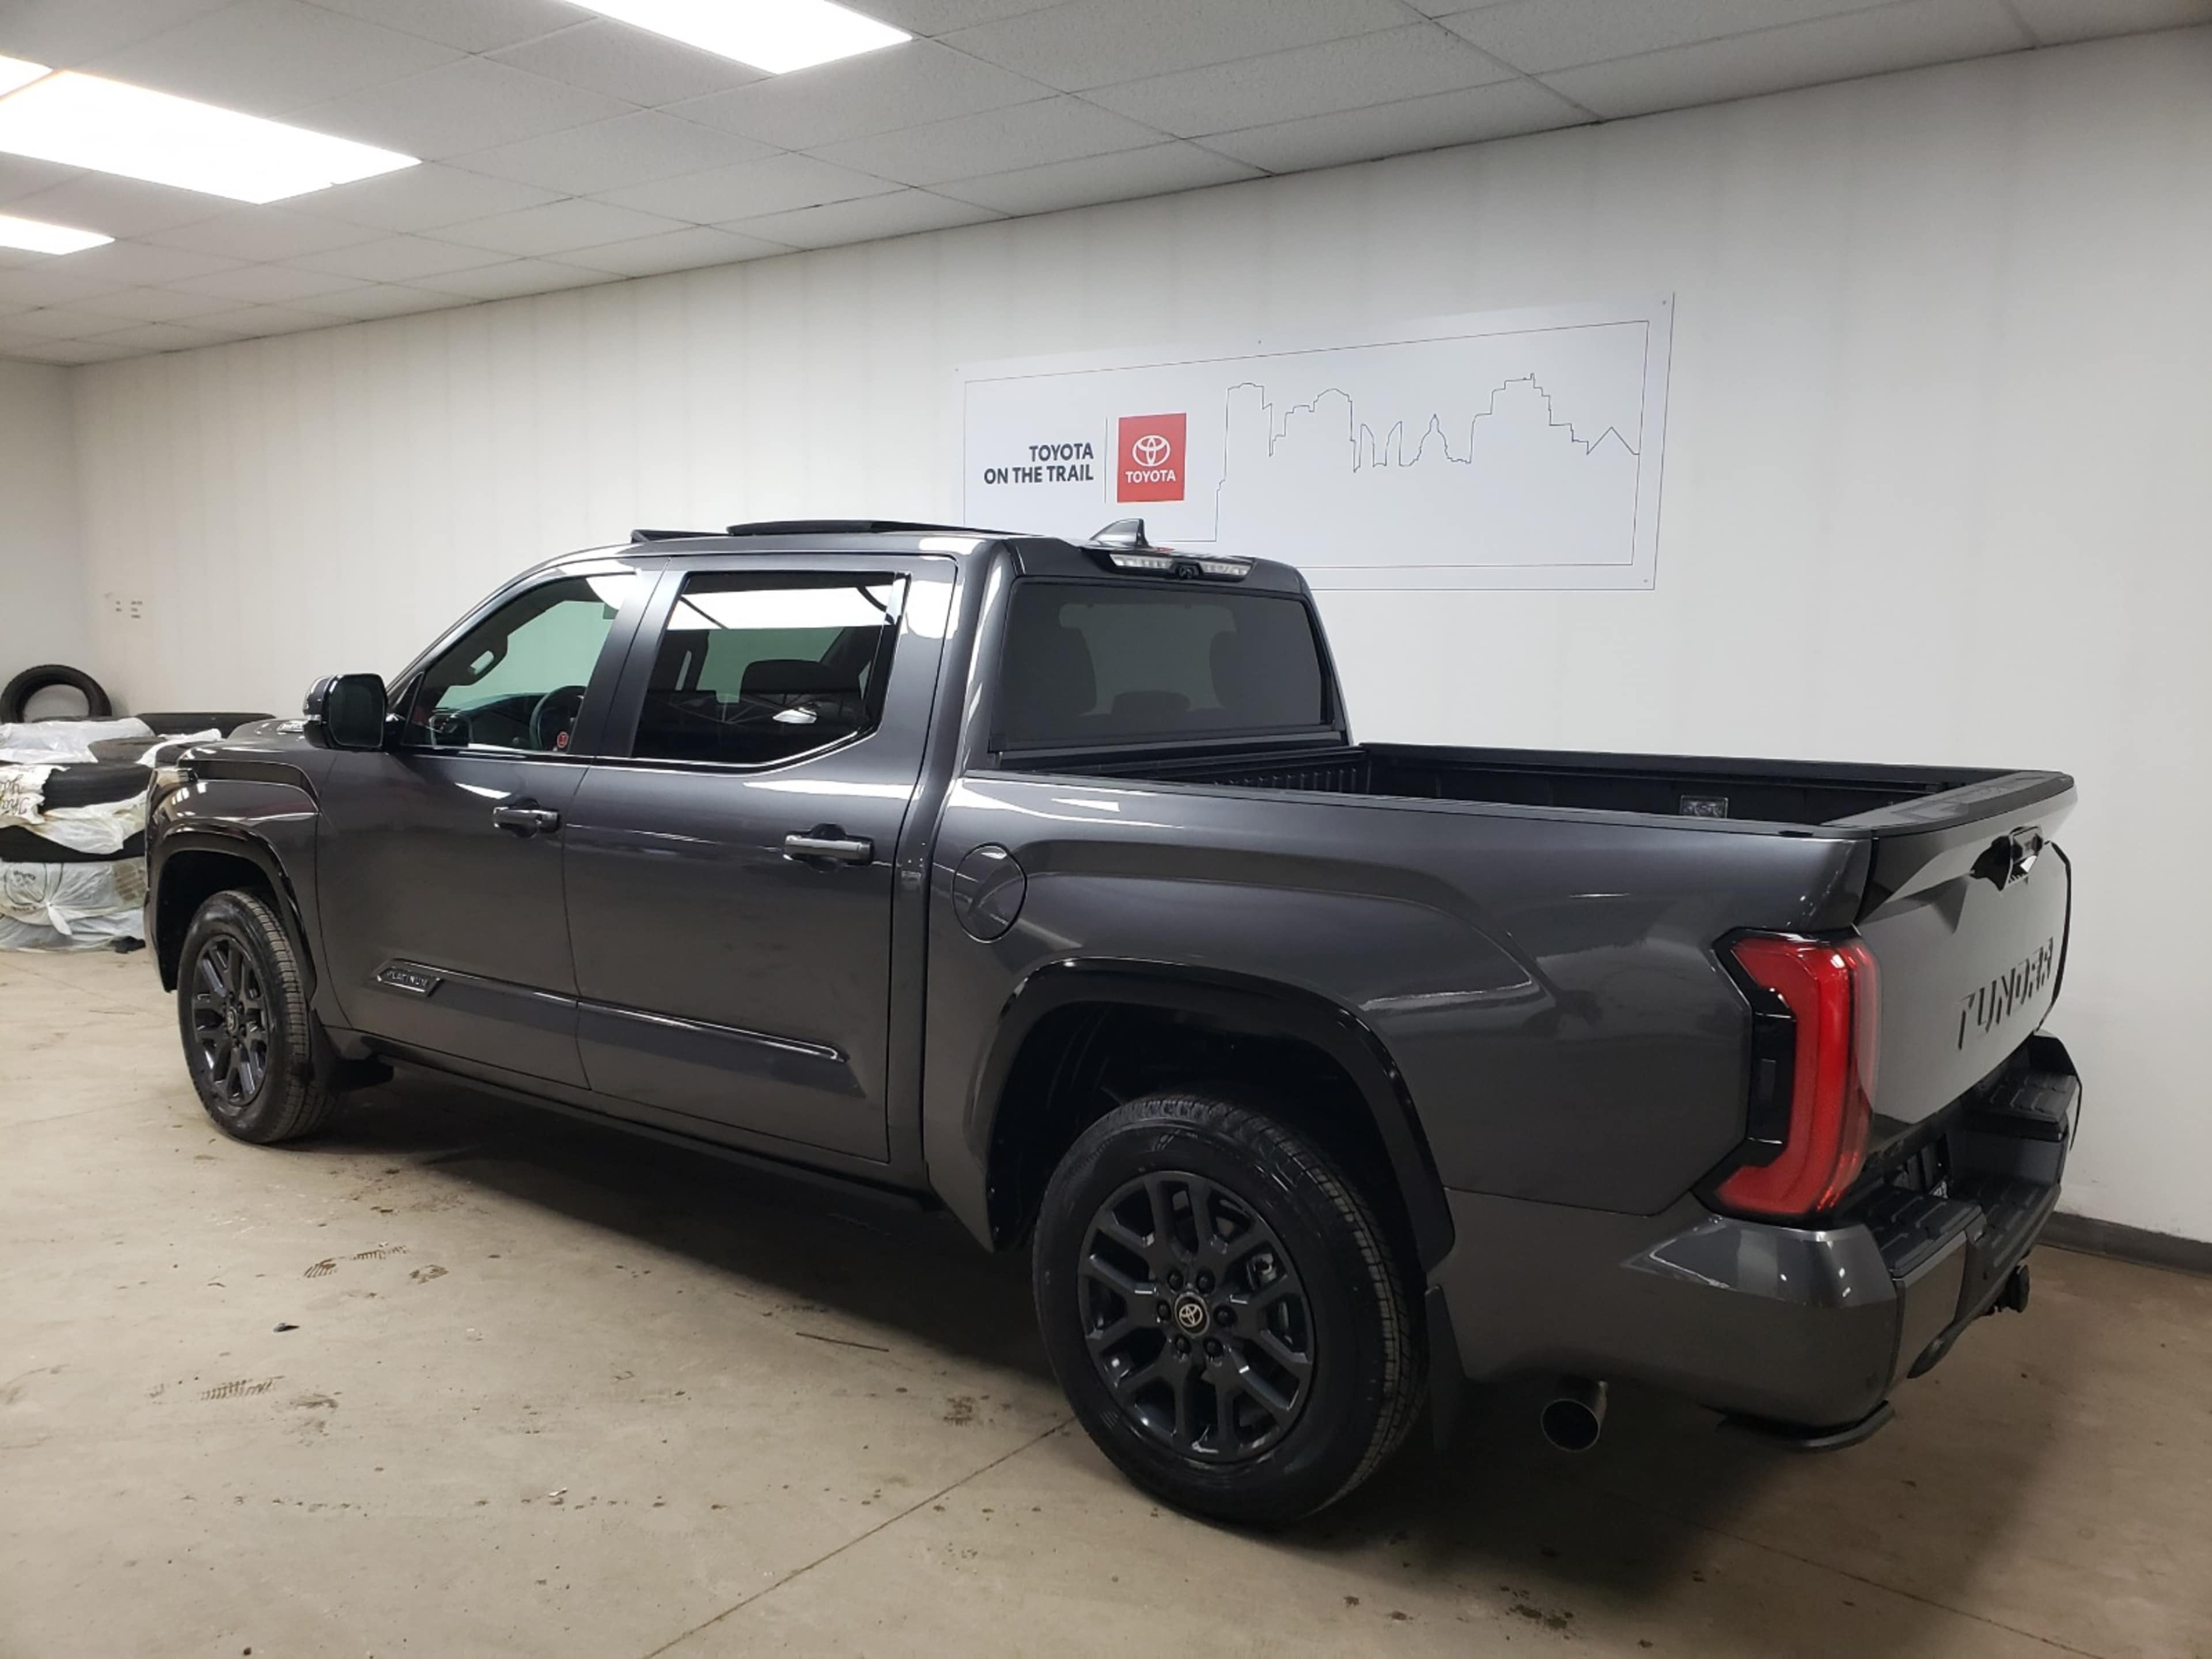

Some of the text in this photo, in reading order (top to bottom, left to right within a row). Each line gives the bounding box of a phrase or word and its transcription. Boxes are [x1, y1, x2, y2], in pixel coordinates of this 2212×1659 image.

[1029, 442, 1094, 462] TOYOTA
[984, 464, 1094, 484] ON THE TRAIL
[1125, 469, 1176, 483] TOYOTA
